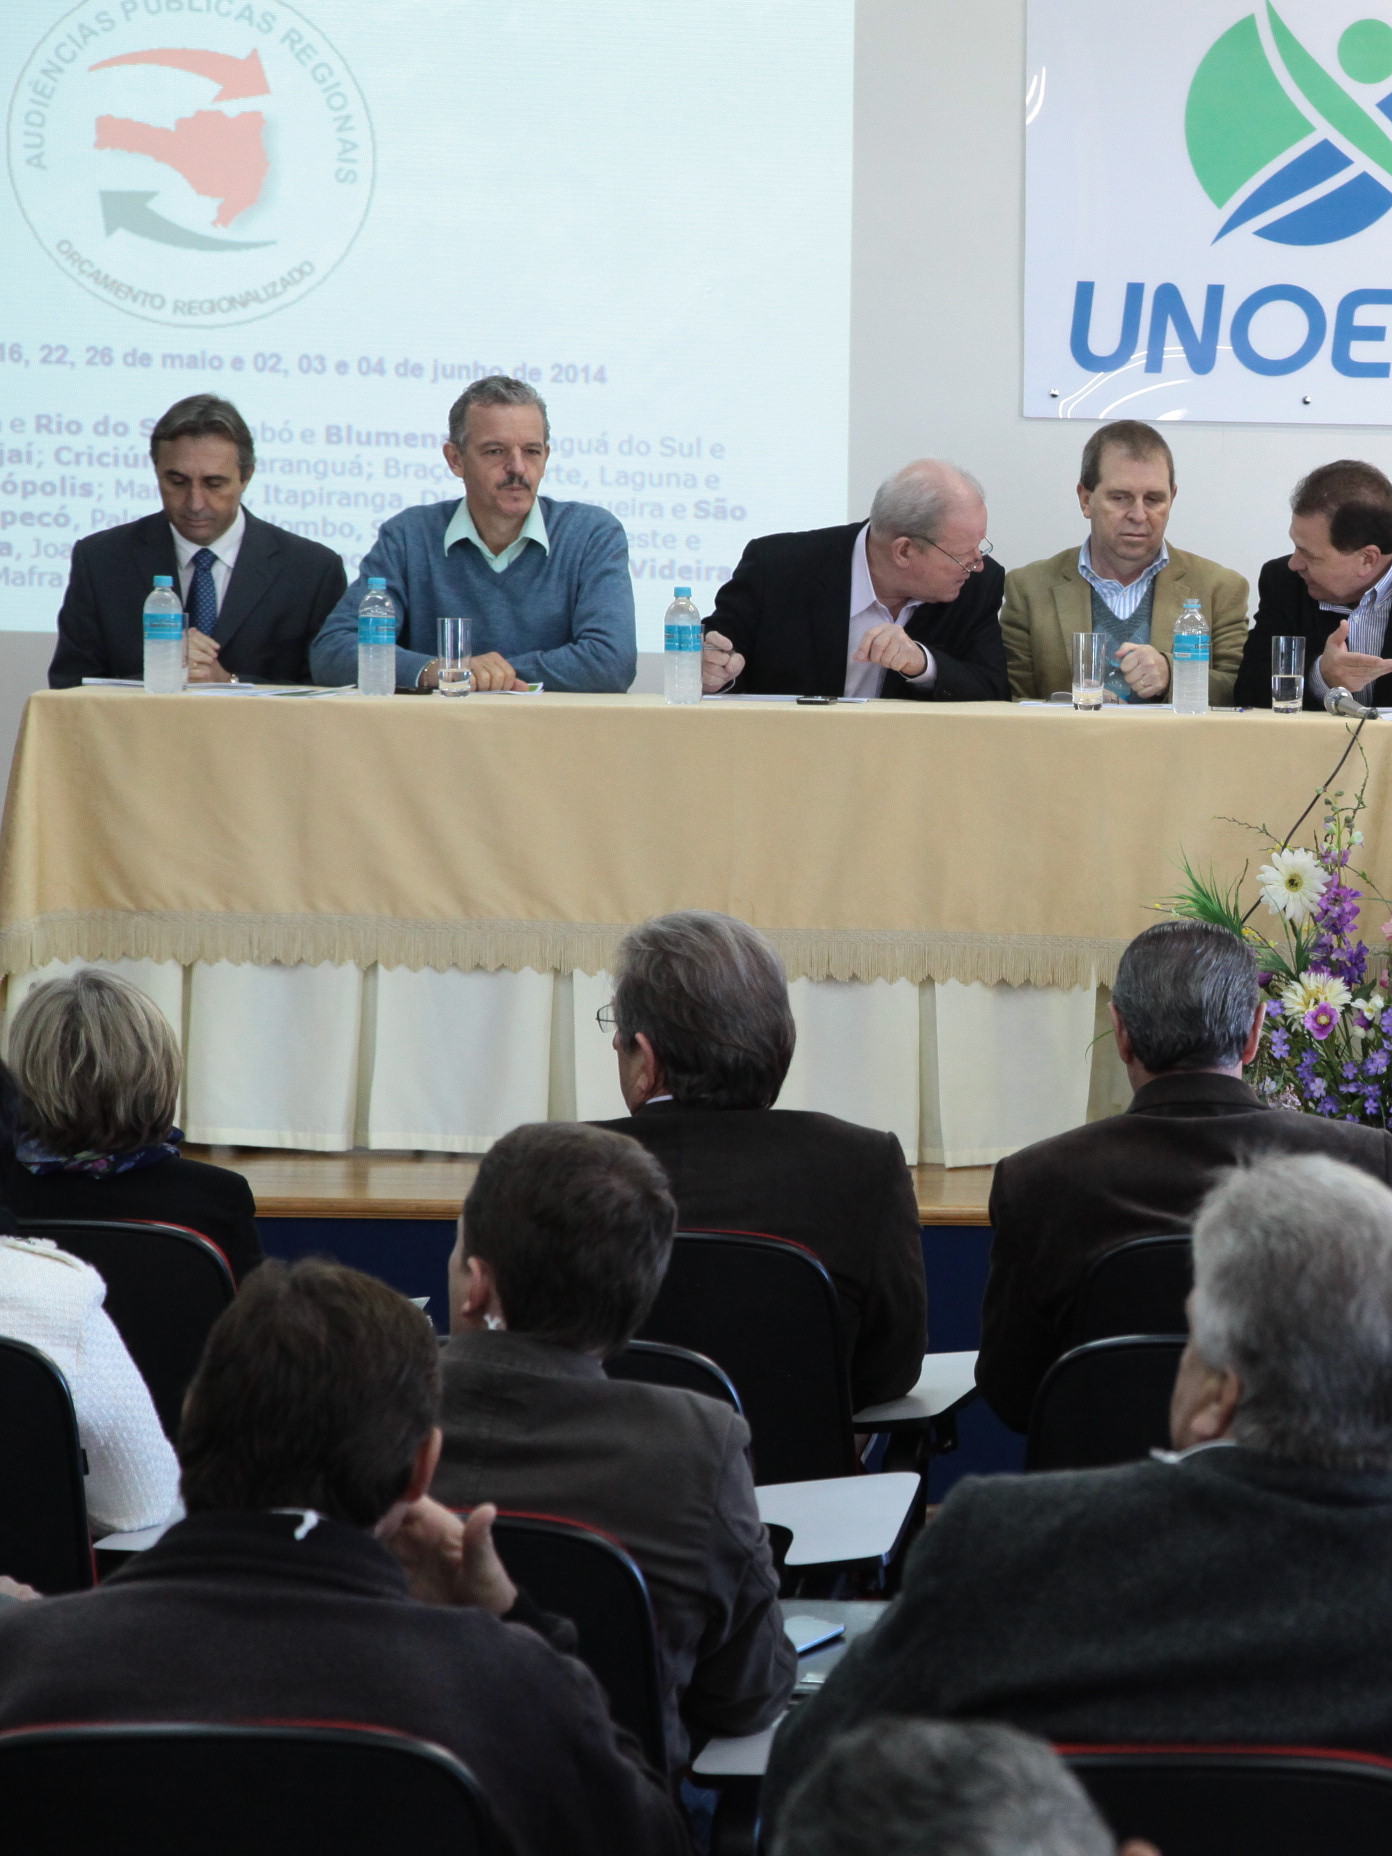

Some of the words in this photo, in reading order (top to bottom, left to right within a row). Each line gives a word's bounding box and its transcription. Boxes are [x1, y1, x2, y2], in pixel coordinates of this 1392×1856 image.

[23, 10, 117, 171] AUDIÊNCIAS
[280, 27, 359, 186] REGIONAIS
[56, 239, 166, 312] ORÇAMENTO
[172, 260, 316, 317] REGIONALIZADO
[39, 344, 76, 369] 22,
[85, 346, 114, 367] 26
[123, 348, 153, 368] de
[161, 349, 223, 371] maio
[230, 355, 245, 371] e
[254, 351, 289, 377] 02,
[298, 353, 327, 375] 03
[335, 359, 349, 376] e
[358, 355, 386, 377] 04
[395, 357, 425, 378] de
[513, 361, 542, 383] de
[550, 363, 608, 385] 2014
[9, 417, 26, 435] e
[35, 413, 83, 436] Rio
[92, 415, 130, 437] do
[300, 427, 316, 445] e
[325, 424, 450, 449] Blumen
[618, 436, 651, 458] do
[659, 436, 701, 460] Sul
[709, 441, 726, 460] e
[600, 466, 698, 493] Laguna
[704, 472, 721, 491] e
[671, 501, 688, 520] e
[693, 498, 747, 522] São
[685, 534, 701, 551] e
[629, 558, 734, 583] Videira
